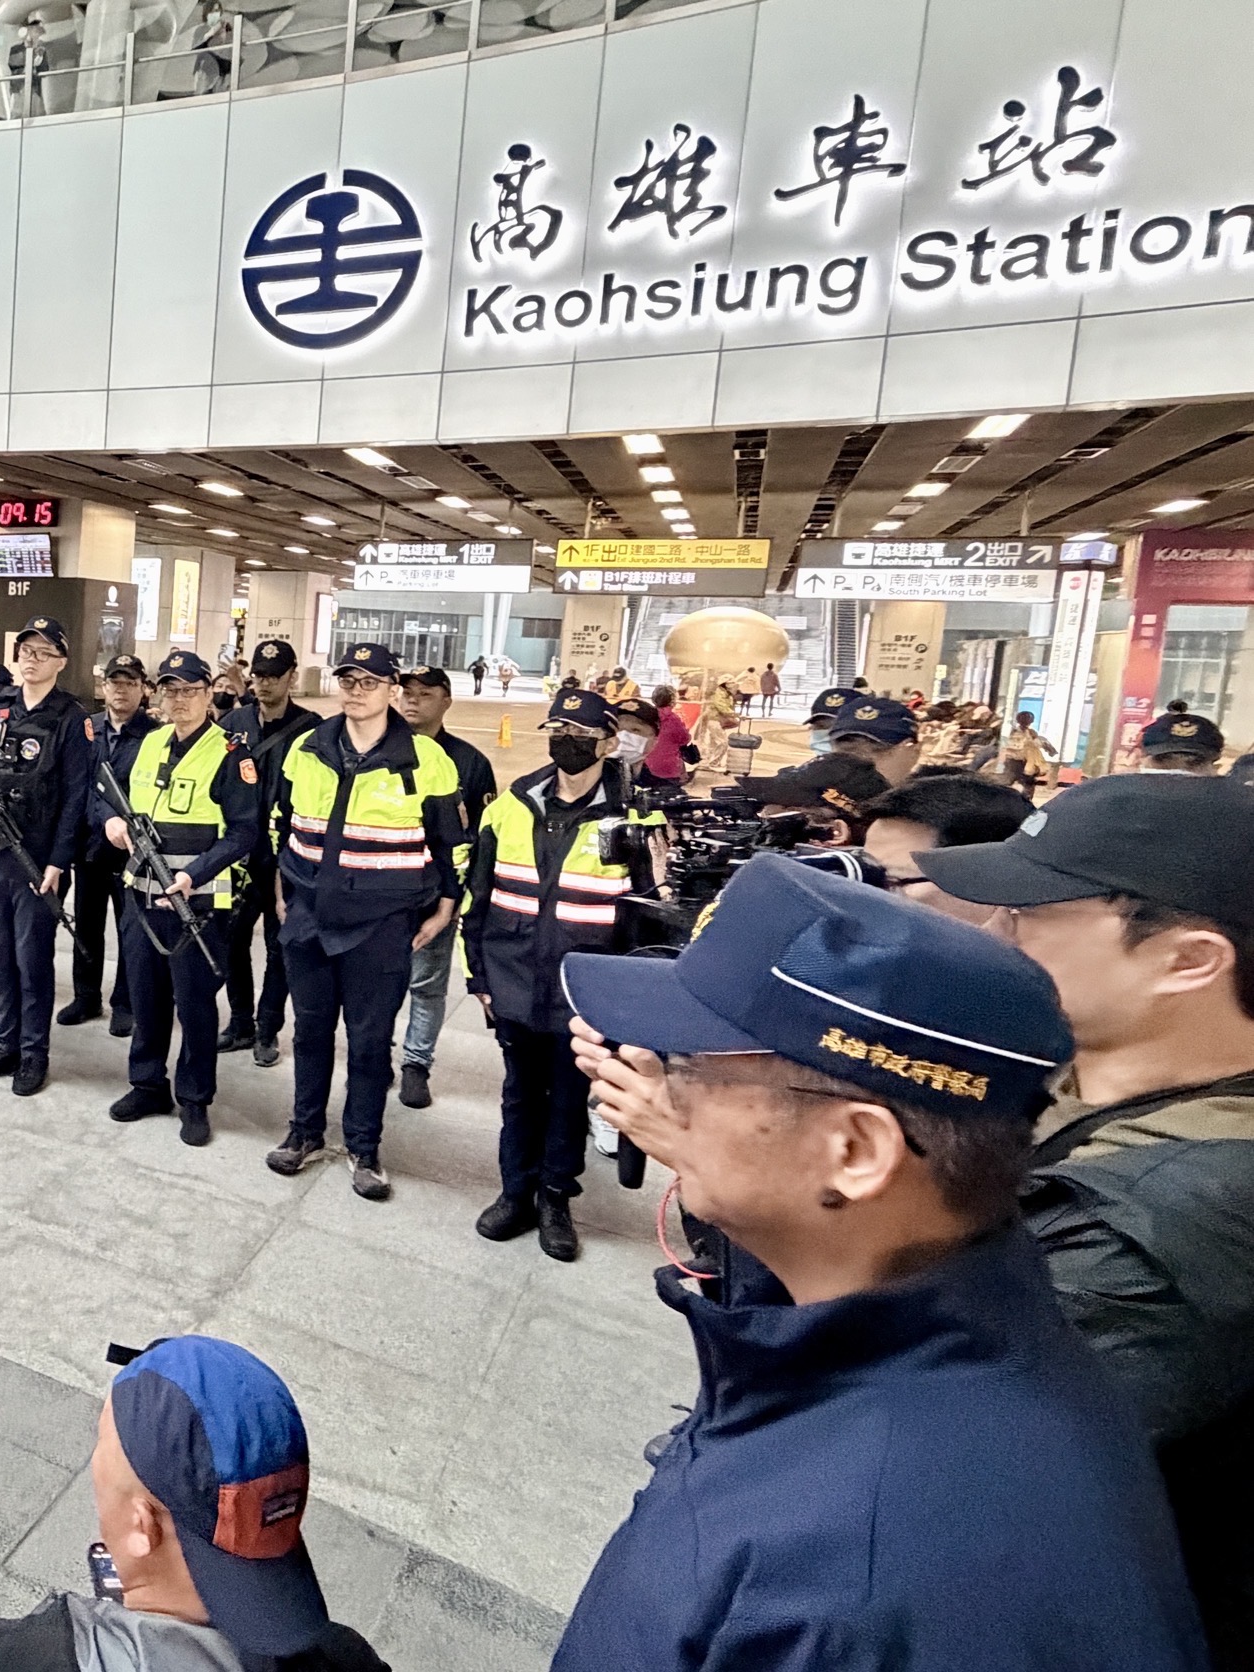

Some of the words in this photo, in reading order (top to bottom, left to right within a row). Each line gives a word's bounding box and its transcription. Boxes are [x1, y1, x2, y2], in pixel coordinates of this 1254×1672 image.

[470, 66, 1117, 261] 高雄車站
[464, 255, 868, 337] Kaohsiung
[900, 207, 1254, 292] Station
[470, 543, 496, 556] 出口
[874, 543, 946, 557] 高雄捷運
[963, 542, 986, 566] 2
[986, 543, 1023, 556] 出口
[469, 555, 494, 564] EXIT
[872, 557, 933, 567] Kaohsiung
[934, 557, 962, 566] MRT
[984, 556, 1021, 566] EXIT
[8, 580, 31, 596] B1F
[889, 573, 1039, 589] 南側汽/機車停車場
[888, 588, 920, 596] South
[923, 588, 965, 598] Parking
[968, 589, 987, 597] Lot
